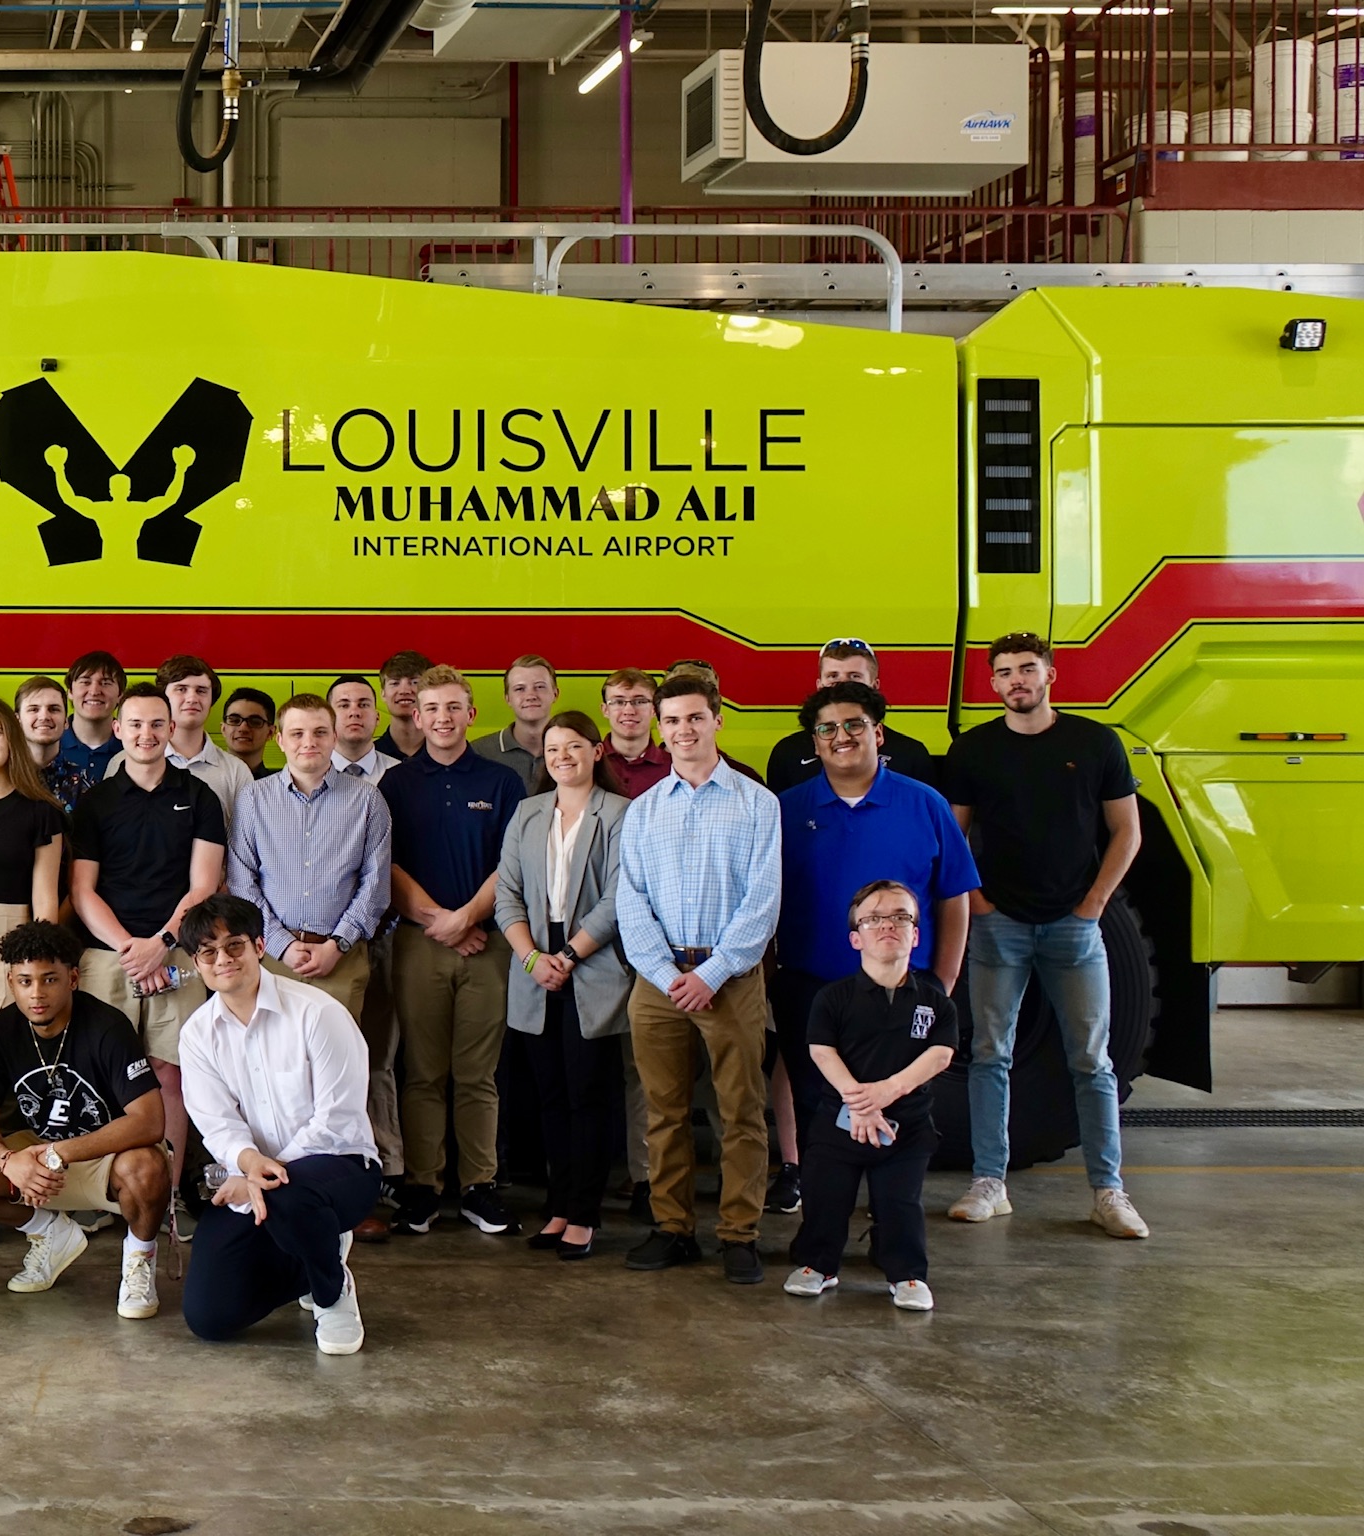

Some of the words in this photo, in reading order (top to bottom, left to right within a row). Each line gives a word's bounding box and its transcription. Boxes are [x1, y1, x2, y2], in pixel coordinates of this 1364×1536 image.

[282, 408, 806, 473] LOUISVILLE
[334, 485, 660, 522] MUHAMMAD
[675, 485, 755, 522] ALI
[354, 536, 593, 557] INTERNATIONAL
[602, 536, 734, 557] AIRPORT
